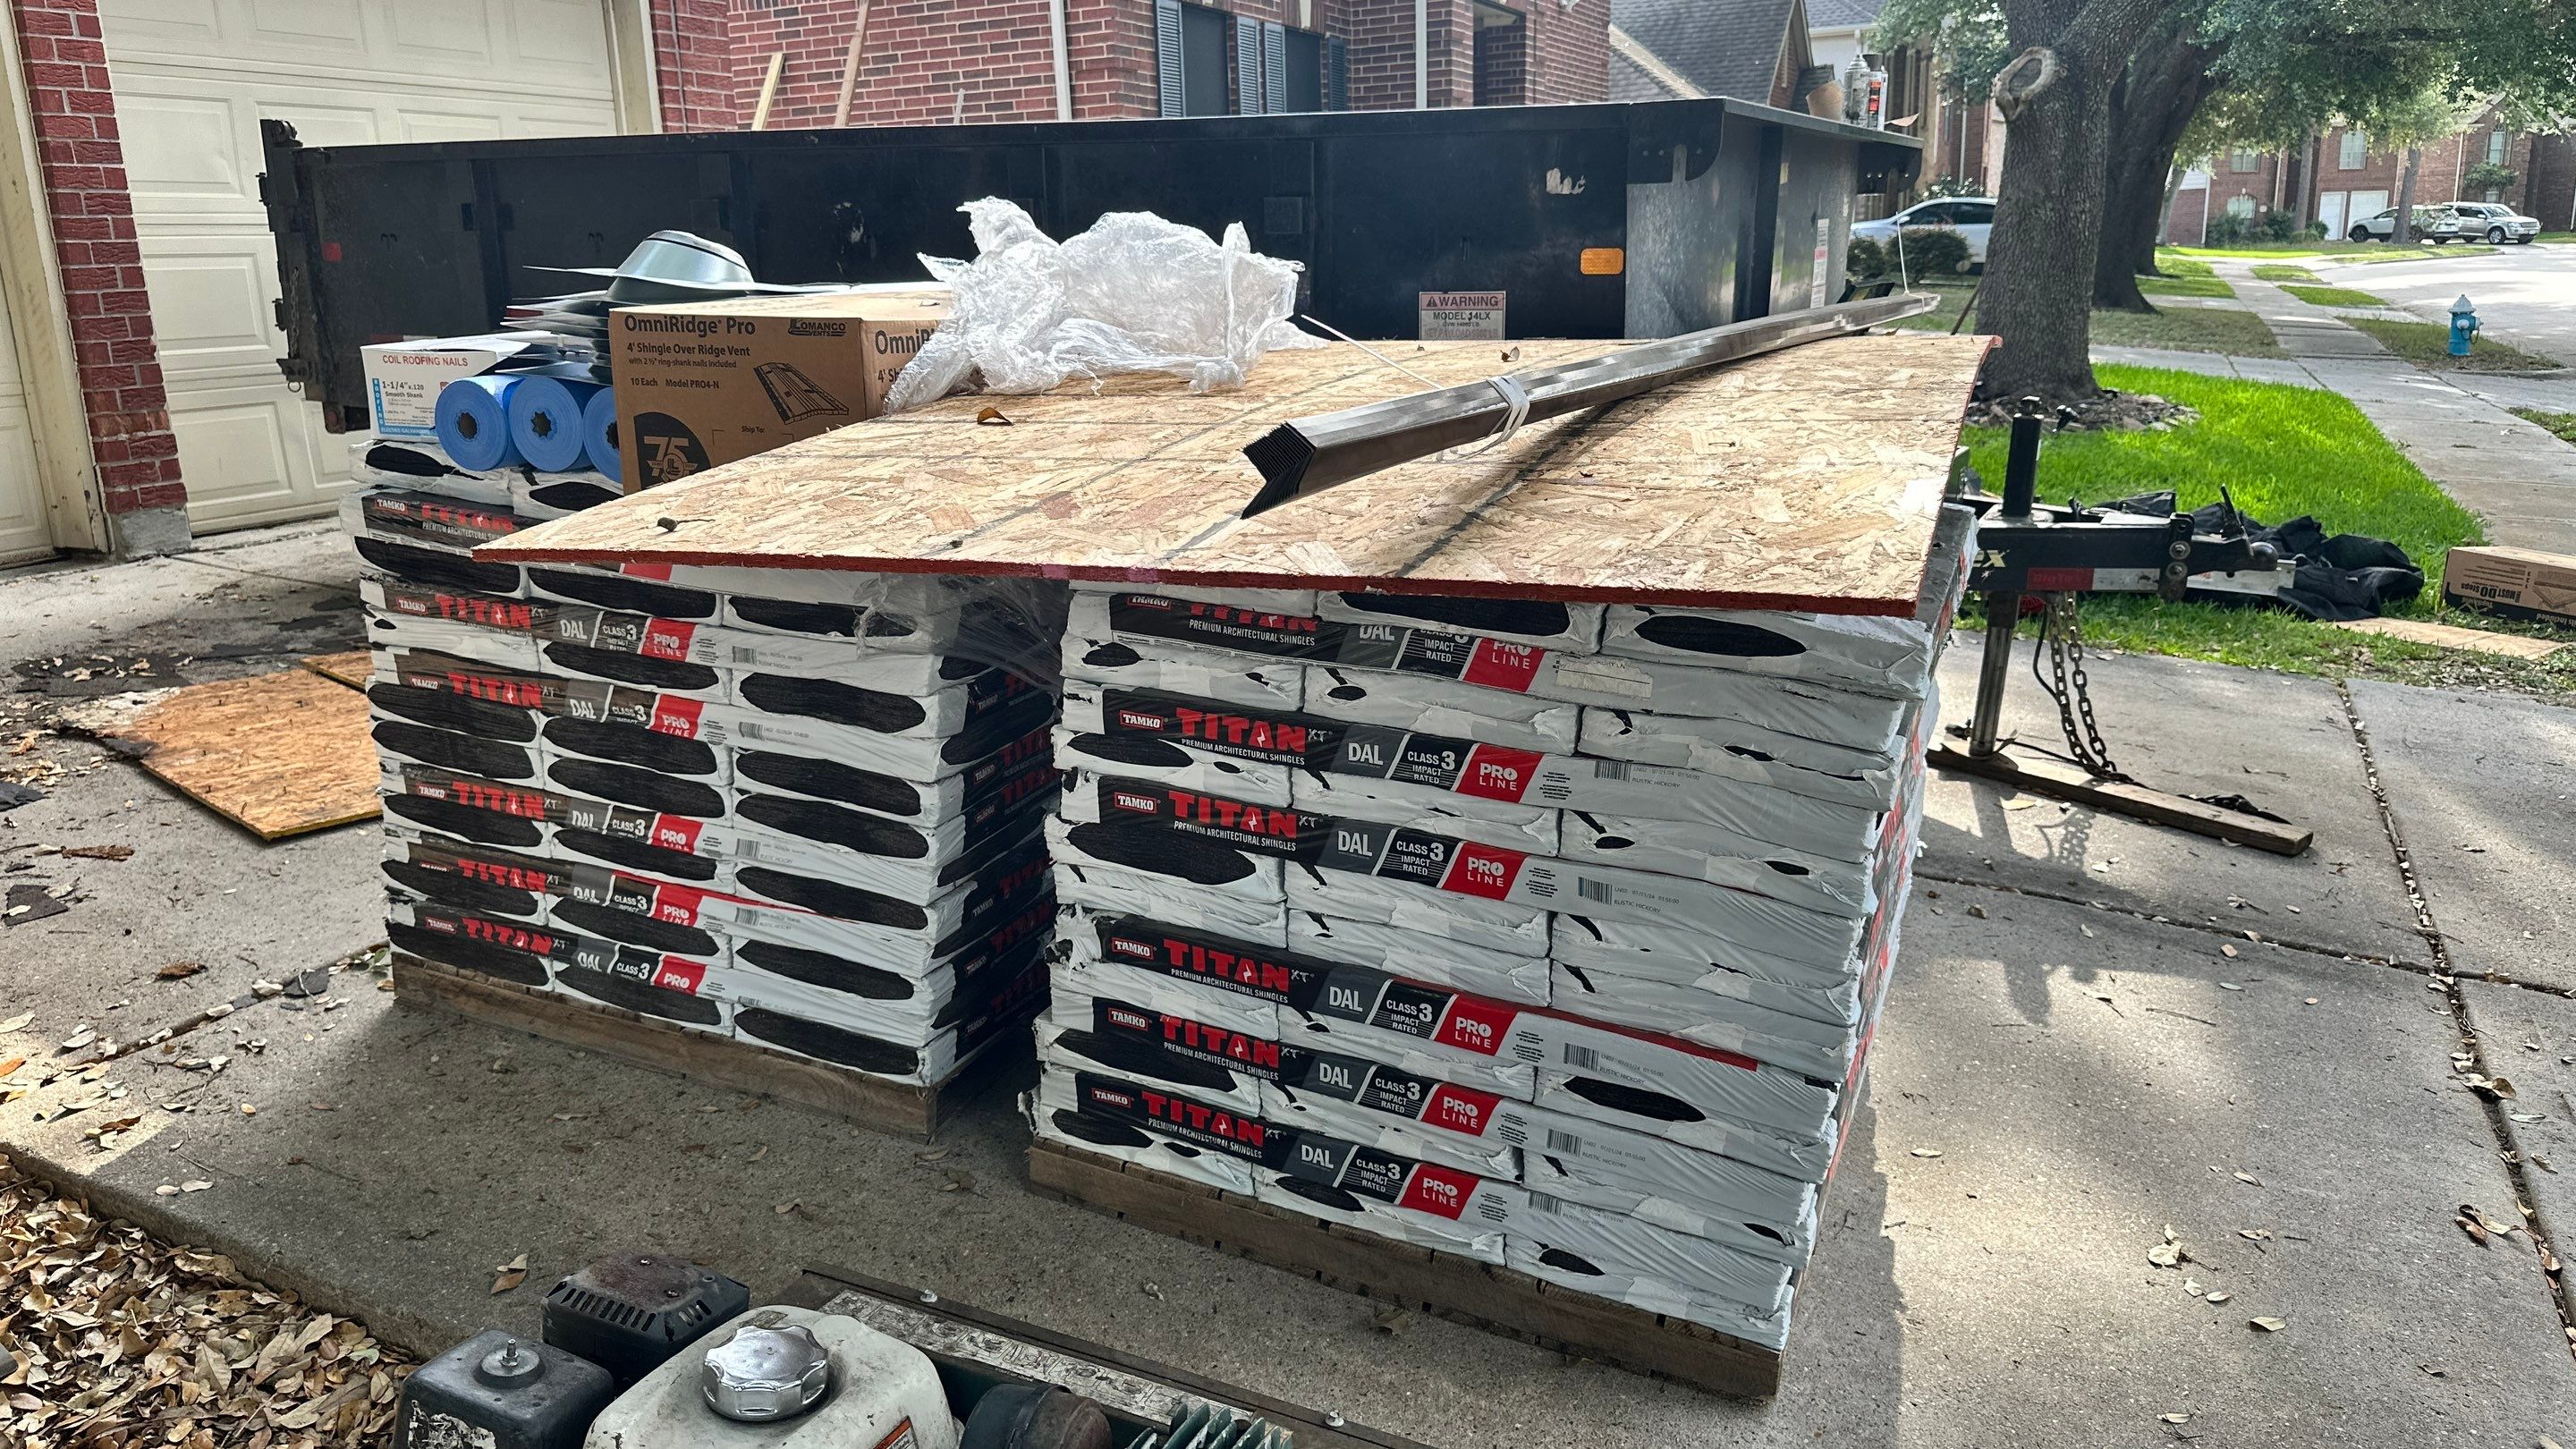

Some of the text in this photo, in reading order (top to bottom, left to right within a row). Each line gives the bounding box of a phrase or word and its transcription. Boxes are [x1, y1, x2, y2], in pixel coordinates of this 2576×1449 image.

[1439, 296, 1498, 307] WARNING
[1433, 311, 1466, 320] MODEL
[726, 318, 756, 335] Pro
[788, 318, 847, 331] LOMANCO
[627, 343, 750, 358] 4' Shingle Over Ridge Vent
[382, 355, 469, 367] COIL ROOFING NAILS
[657, 360, 691, 368] ring-shank
[708, 360, 737, 369] included
[630, 377, 719, 389] 10 Each Model PRO4-N
[741, 426, 753, 434] Ship
[644, 436, 689, 477] 75
[377, 499, 405, 512] TAMKO
[422, 521, 447, 534] PREMIUM
[2479, 587, 2497, 598] DO
[2496, 588, 2516, 599] MUST
[435, 593, 531, 630] TITAN
[2537, 614, 2568, 625] Included
[560, 619, 588, 640] DAL
[603, 624, 638, 640] CLASS 3
[1189, 619, 1316, 647] PREMIUM ARCHITECTURAL SHINGLES
[1359, 625, 1395, 641] DAL
[654, 632, 680, 649] PRO
[1424, 638, 1455, 652] IMPACT
[654, 646, 682, 657] LINE
[1426, 650, 1452, 663] RATED
[1492, 652, 1530, 669] LINE
[447, 672, 543, 708] TITAN
[570, 699, 597, 719] DAL
[612, 705, 648, 721] CLASS 3
[663, 715, 690, 730] PRO
[1123, 713, 1160, 728] TAMKO
[662, 727, 690, 738] LINE
[1176, 707, 1307, 753] TITAN
[1181, 738, 1305, 766] PREMIUM ARCHITECTURAL SHINGLES
[1348, 742, 1384, 766] DAL
[1408, 750, 1455, 770] CLASS 3
[1412, 764, 1441, 776] IMPACT
[1479, 762, 1518, 781] PRO
[1413, 774, 1440, 784] RATED
[1479, 776, 1517, 791] LINE
[453, 781, 546, 820] TITAN
[1117, 795, 1154, 811] TAMKO
[1168, 791, 1297, 839] TITAN
[612, 819, 635, 832] CLASS
[634, 818, 646, 836] 3
[661, 829, 687, 845] PRO
[1174, 820, 1297, 852] PREMIUM ARCHITECTURAL SHINGLES
[1337, 830, 1373, 857] DAL
[1396, 841, 1445, 861] CLASS 3
[1401, 855, 1430, 868] IMPACT
[1402, 864, 1428, 876] RATED
[1468, 856, 1504, 877] PRO
[457, 859, 547, 893] TITAN
[1467, 871, 1504, 887] LINE
[614, 895, 648, 910] CLASS 3
[664, 905, 690, 919] PRO
[462, 917, 552, 956] TITAN
[1114, 940, 1150, 957] TAMKO
[577, 952, 602, 972] DAL
[617, 962, 650, 979] CLASS 3
[1164, 939, 1289, 992] TITAN
[664, 972, 691, 988] PRO
[1171, 968, 1288, 1004] PREMIUM ARCHITECTURAL SHINGLES
[1329, 986, 1363, 1013] DAL
[1386, 999, 1433, 1022] CLASS 3
[1111, 1012, 1146, 1029] TAMKO
[1391, 1013, 1419, 1027] IMPACT
[1392, 1021, 1417, 1035] RATED
[1455, 1017, 1492, 1038] PRO
[1160, 1013, 1280, 1068] TITAN
[1455, 1031, 1492, 1049] LINE
[1164, 1041, 1279, 1081] PREMIUM ARCHITECTURAL SHINGLES
[1319, 1063, 1353, 1089] DAL
[1095, 1089, 1128, 1105] TAMKO
[1376, 1078, 1420, 1100] CLASS 3
[1379, 1091, 1408, 1106] IMPACT
[1381, 1100, 1405, 1114] RATED
[1443, 1096, 1479, 1117] PRO
[1142, 1090, 1264, 1147] TITAN
[1442, 1111, 1478, 1129] LINE
[1148, 1117, 1262, 1159] PREMIUM ARCHITECTURAL SHINGLES
[1301, 1144, 1334, 1169] DAL
[1356, 1158, 1401, 1180] CLASS 3
[1360, 1170, 1388, 1186] IMPACT
[1361, 1180, 1385, 1192] RATED
[1423, 1177, 1458, 1197] PRO
[1422, 1190, 1458, 1208] LINE
